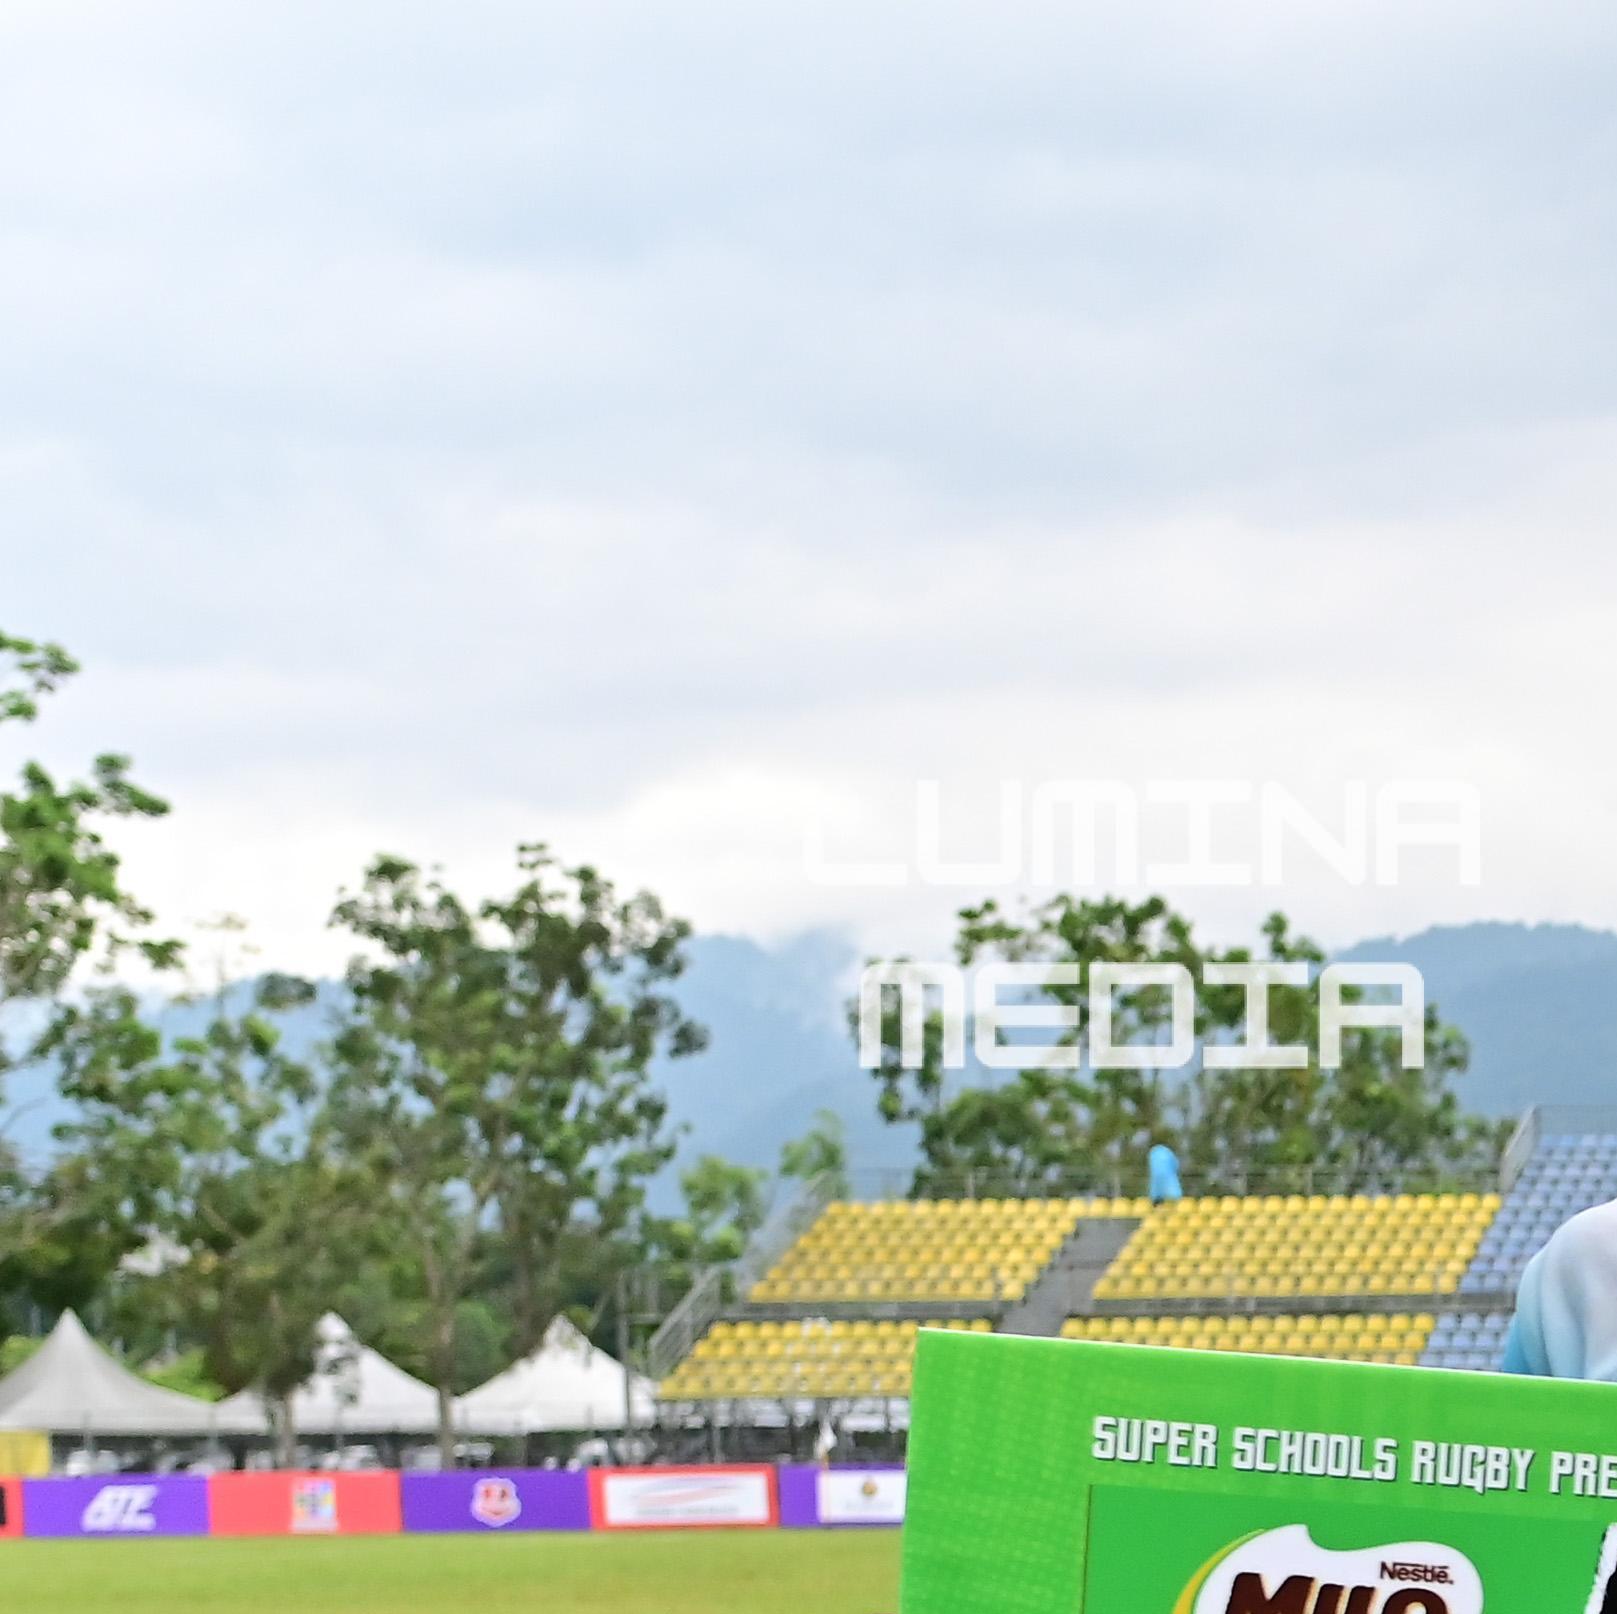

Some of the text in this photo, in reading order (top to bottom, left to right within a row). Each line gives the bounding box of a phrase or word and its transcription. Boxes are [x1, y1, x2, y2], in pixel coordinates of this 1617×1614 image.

[1092, 1415, 1218, 1467] SUPER
[1232, 1426, 1398, 1481] SCHOOLS
[1411, 1440, 1536, 1494] RUGBY
